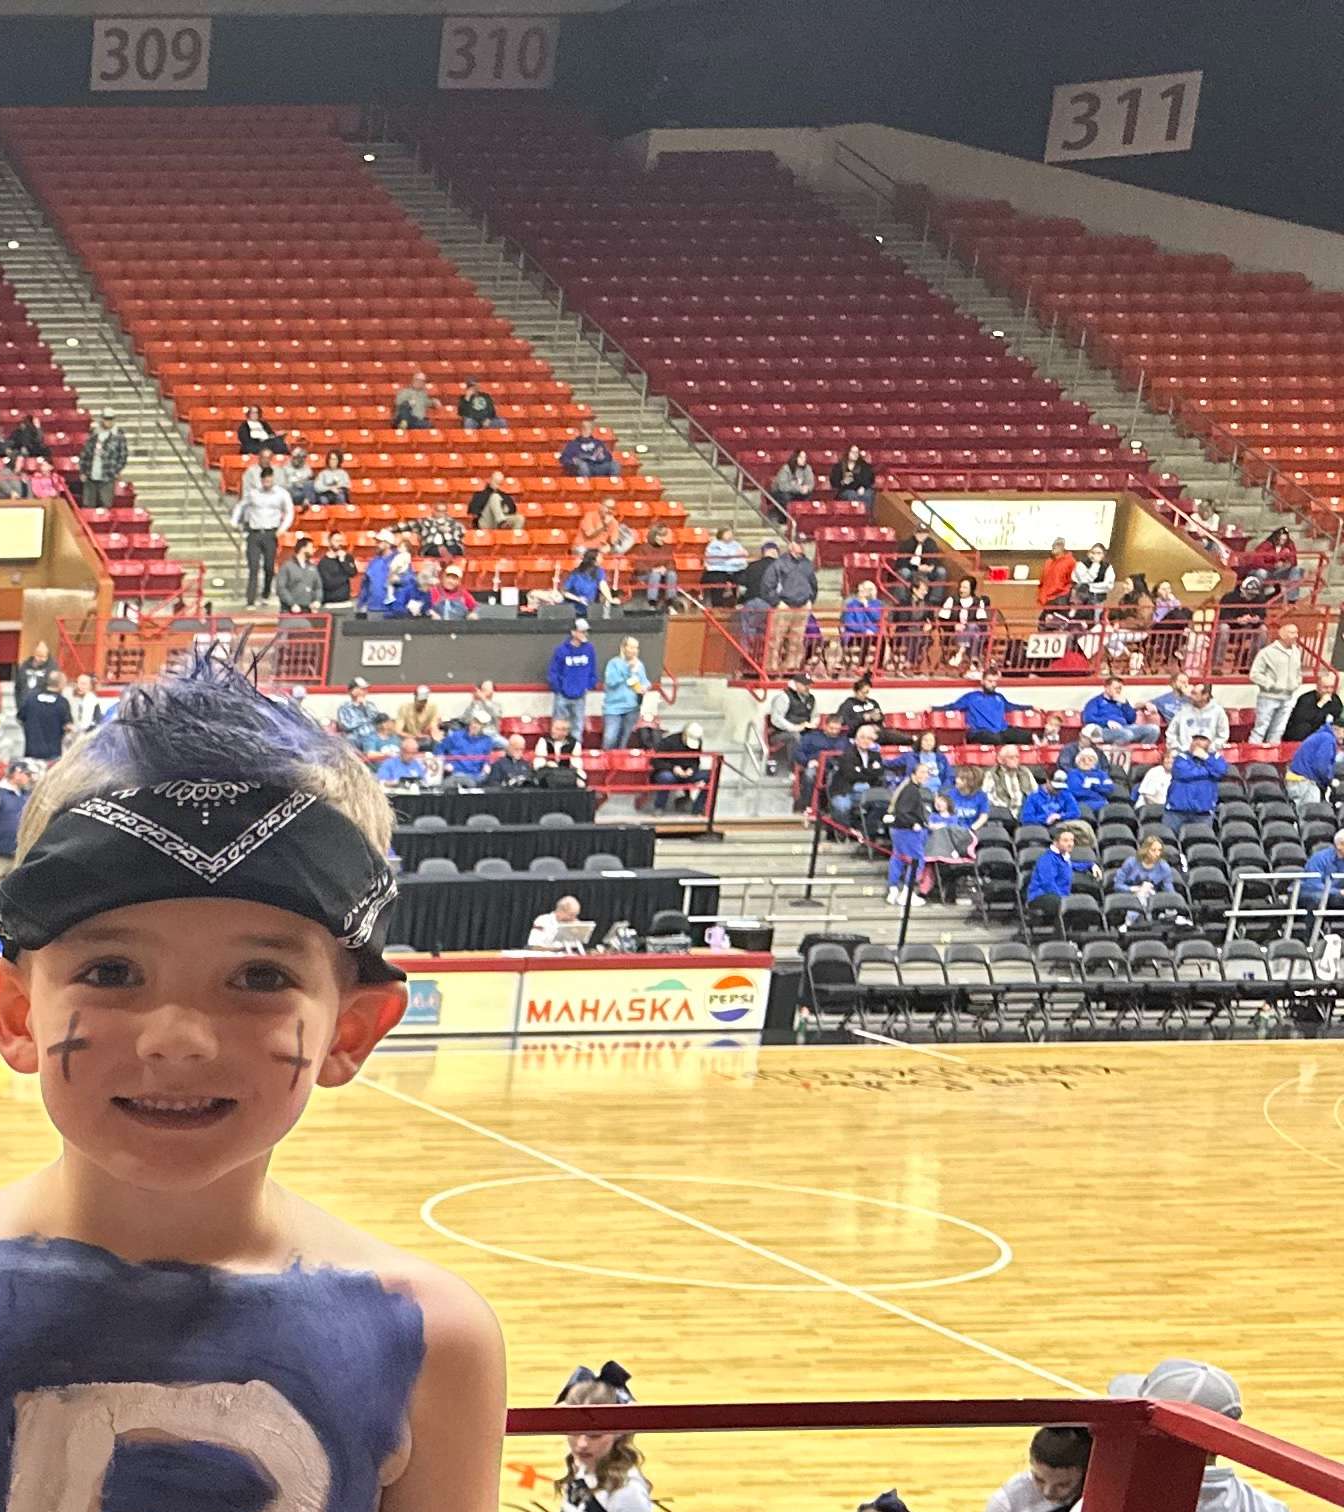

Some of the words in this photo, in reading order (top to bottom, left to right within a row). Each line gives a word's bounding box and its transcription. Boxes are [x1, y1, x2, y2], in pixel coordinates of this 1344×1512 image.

[100, 27, 202, 81] 309
[446, 26, 546, 79] 310
[1062, 83, 1186, 150] 311
[1031, 637, 1062, 654] 210
[526, 998, 695, 1024] MAHASKA
[708, 994, 755, 1005] PEPSI
